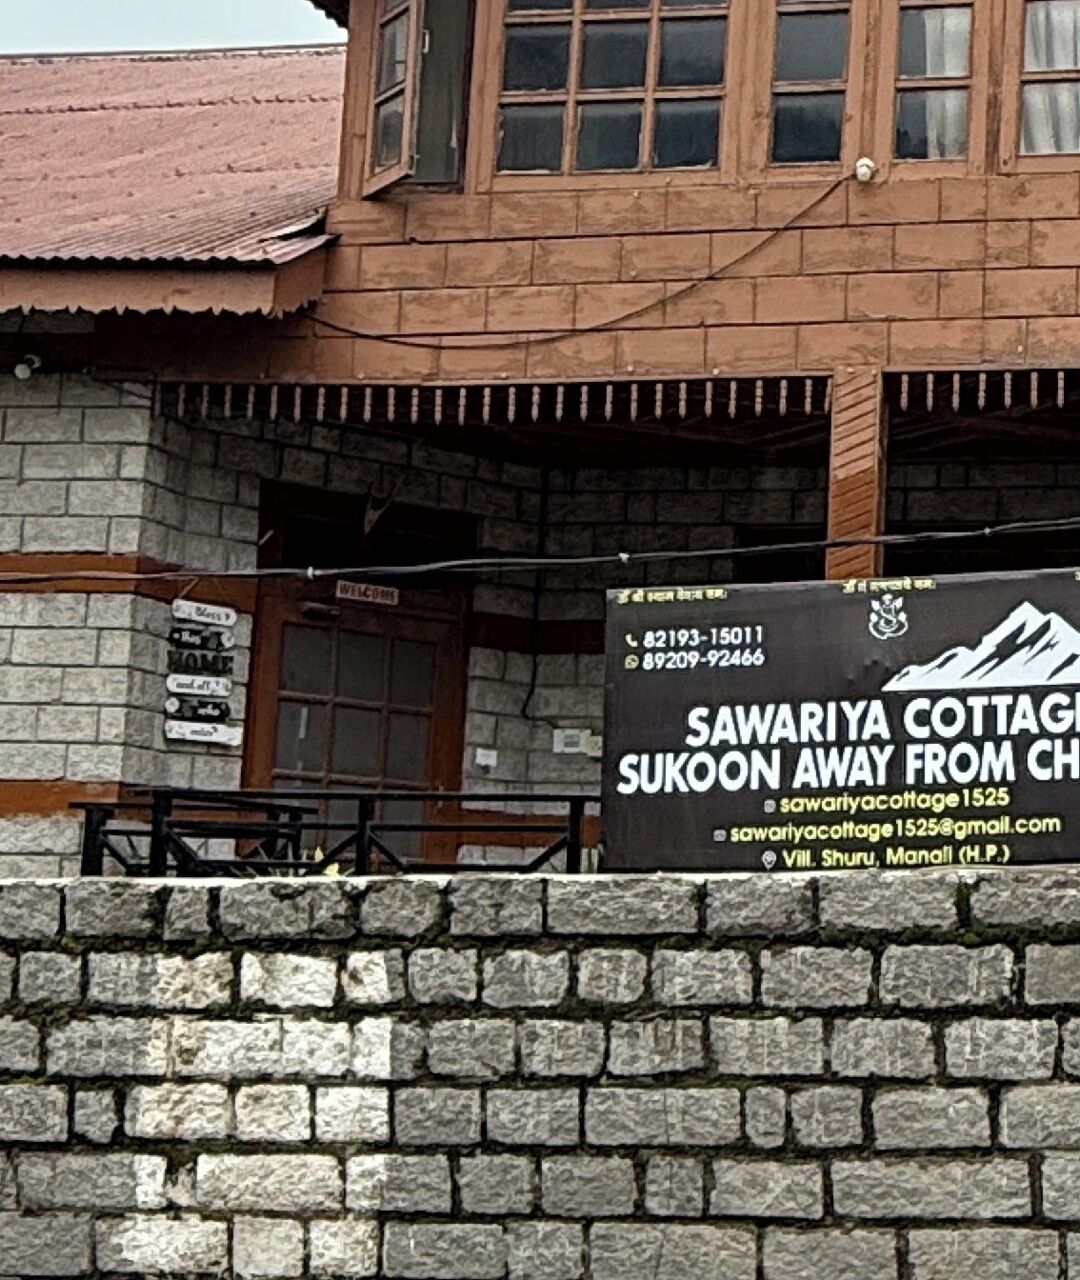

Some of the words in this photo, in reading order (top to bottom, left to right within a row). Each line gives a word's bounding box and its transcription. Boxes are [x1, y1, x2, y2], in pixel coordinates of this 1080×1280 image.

[642, 625, 763, 648] 82193-15011
[168, 650, 234, 675] HOME
[642, 648, 765, 670] 89209-92466
[685, 699, 891, 747] SAWARIYA
[616, 749, 781, 795] SUKOON
[792, 745, 895, 789] AWAY
[905, 739, 1016, 784] FROM
[779, 787, 1010, 815] sawariyacottage1525
[730, 815, 1061, 844] sawariyacottage1525@gmail.com
[782, 848, 816, 867] Vill.
[821, 847, 880, 867] Shuru,
[885, 845, 953, 865] Manali
[958, 844, 1010, 864] (H.P.)
